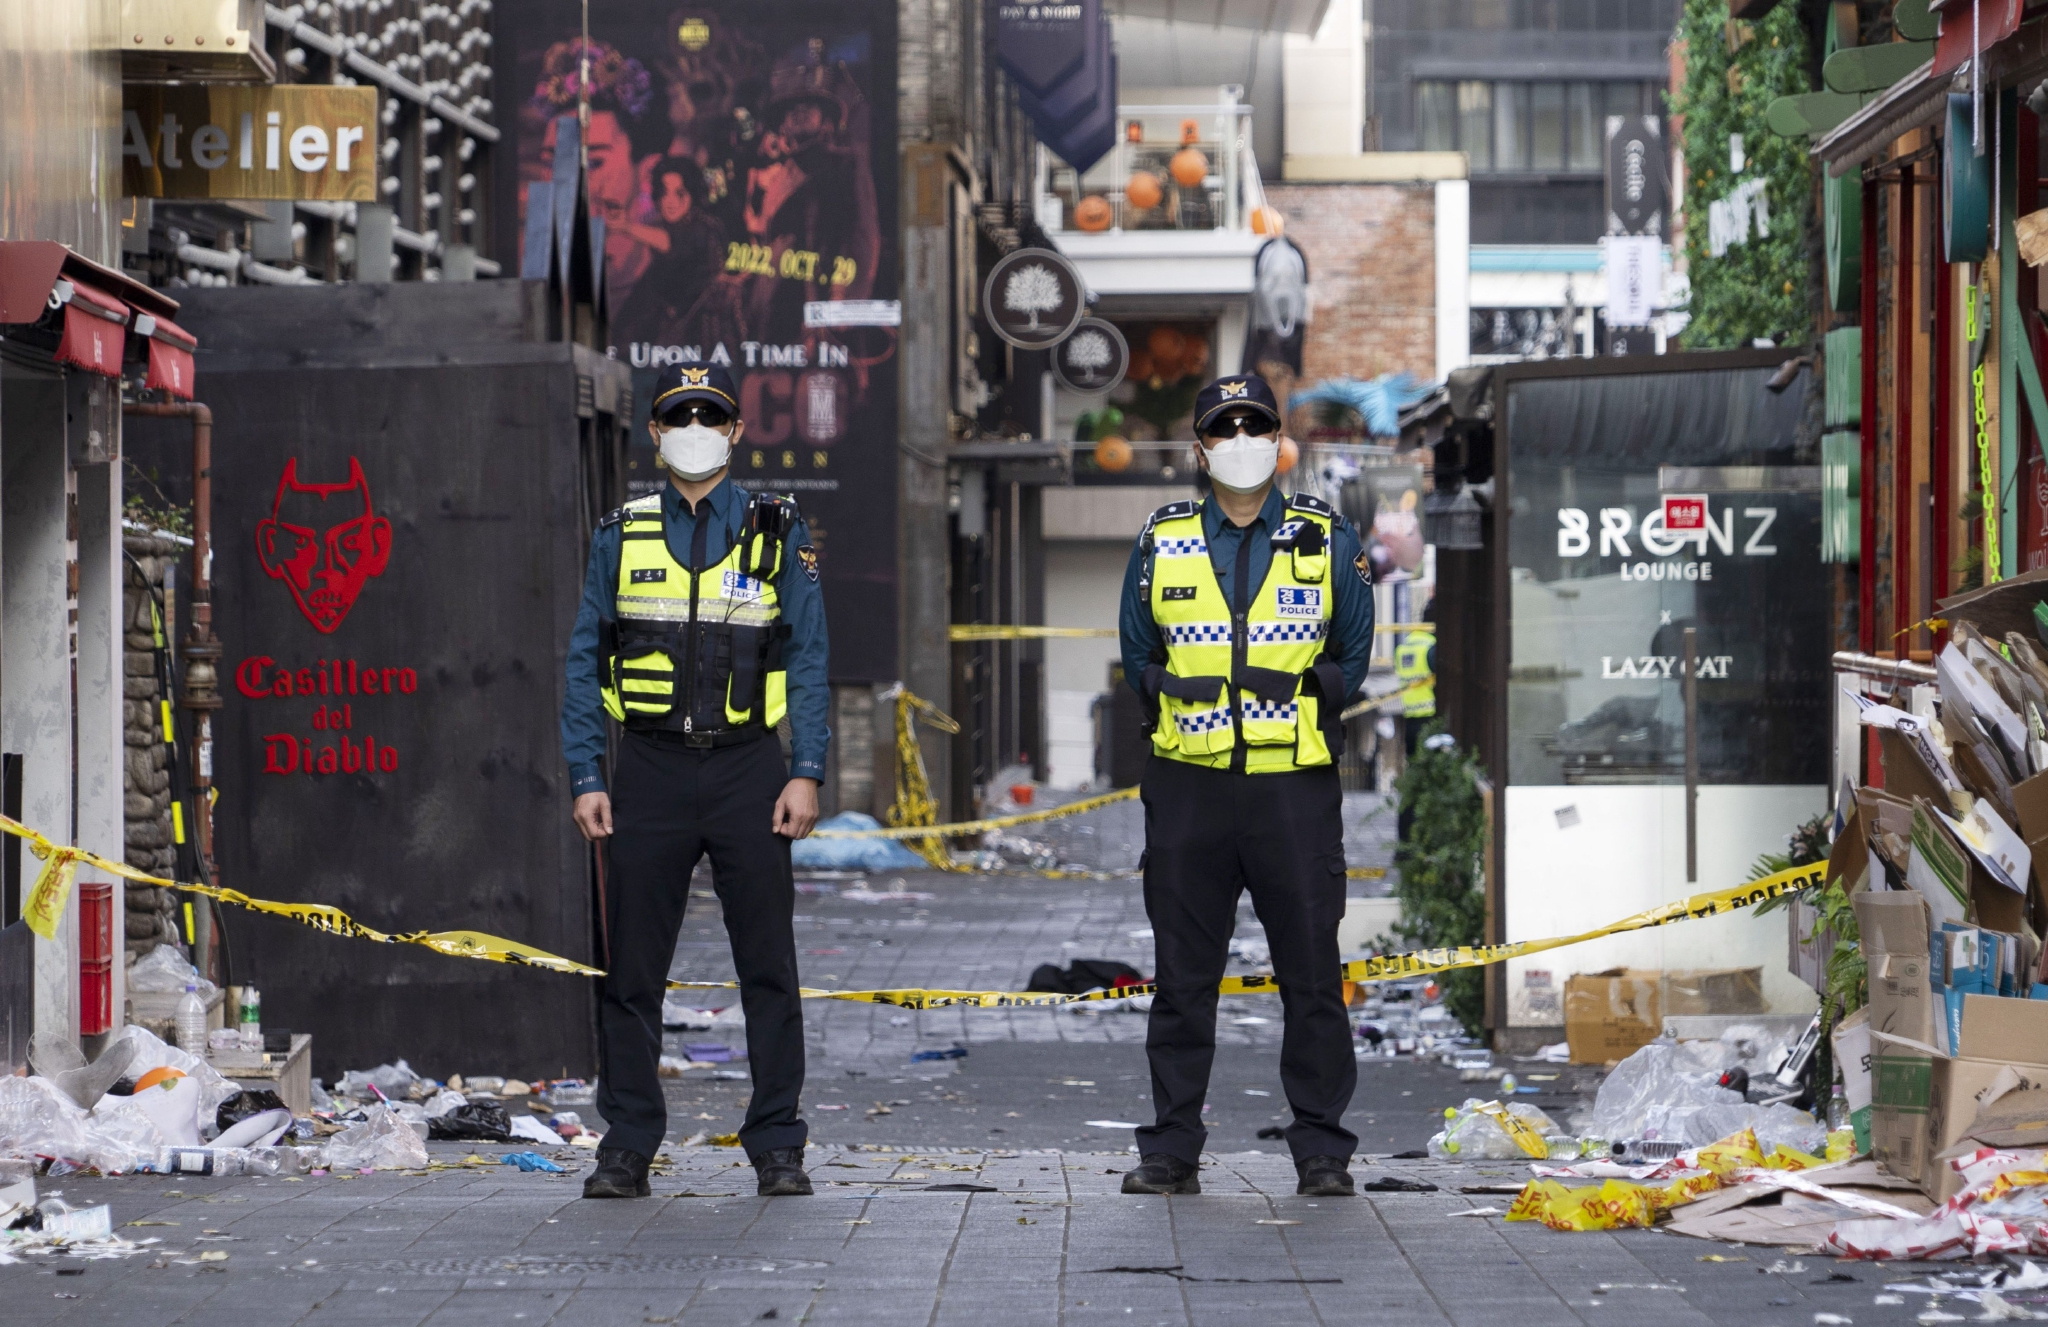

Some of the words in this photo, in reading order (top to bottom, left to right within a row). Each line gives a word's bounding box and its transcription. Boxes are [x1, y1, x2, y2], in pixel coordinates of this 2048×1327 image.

[123, 110, 363, 172] Atelier
[831, 255, 858, 287] 29
[709, 341, 732, 367] A
[1620, 562, 1713, 581] LOUNGE
[723, 588, 758, 600] POLICE
[1280, 588, 1318, 606] 경찰
[1280, 605, 1318, 615] POLICE
[235, 655, 417, 699] Casillero
[1600, 655, 1677, 679] LAZY
[313, 703, 352, 730] del
[263, 733, 398, 776] Diablo
